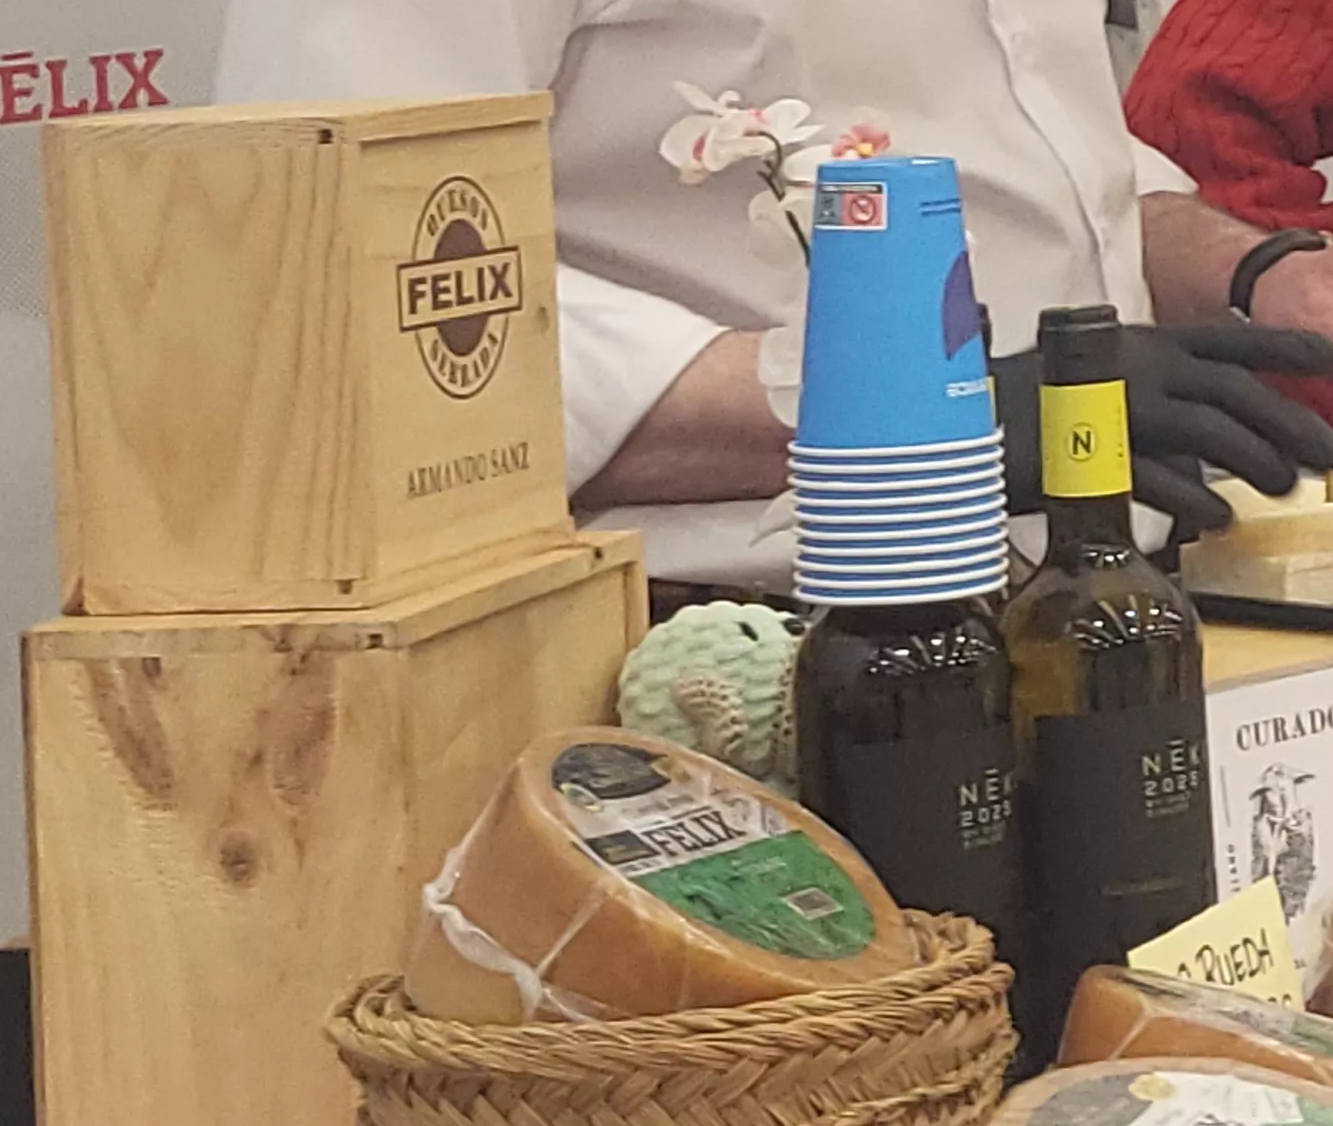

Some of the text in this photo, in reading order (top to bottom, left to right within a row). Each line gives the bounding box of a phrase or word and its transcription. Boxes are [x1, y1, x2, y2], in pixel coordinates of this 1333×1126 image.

[407, 261, 514, 316] FELIX
[407, 441, 530, 499] ARMANDO SANZ
[1072, 430, 1092, 455] N
